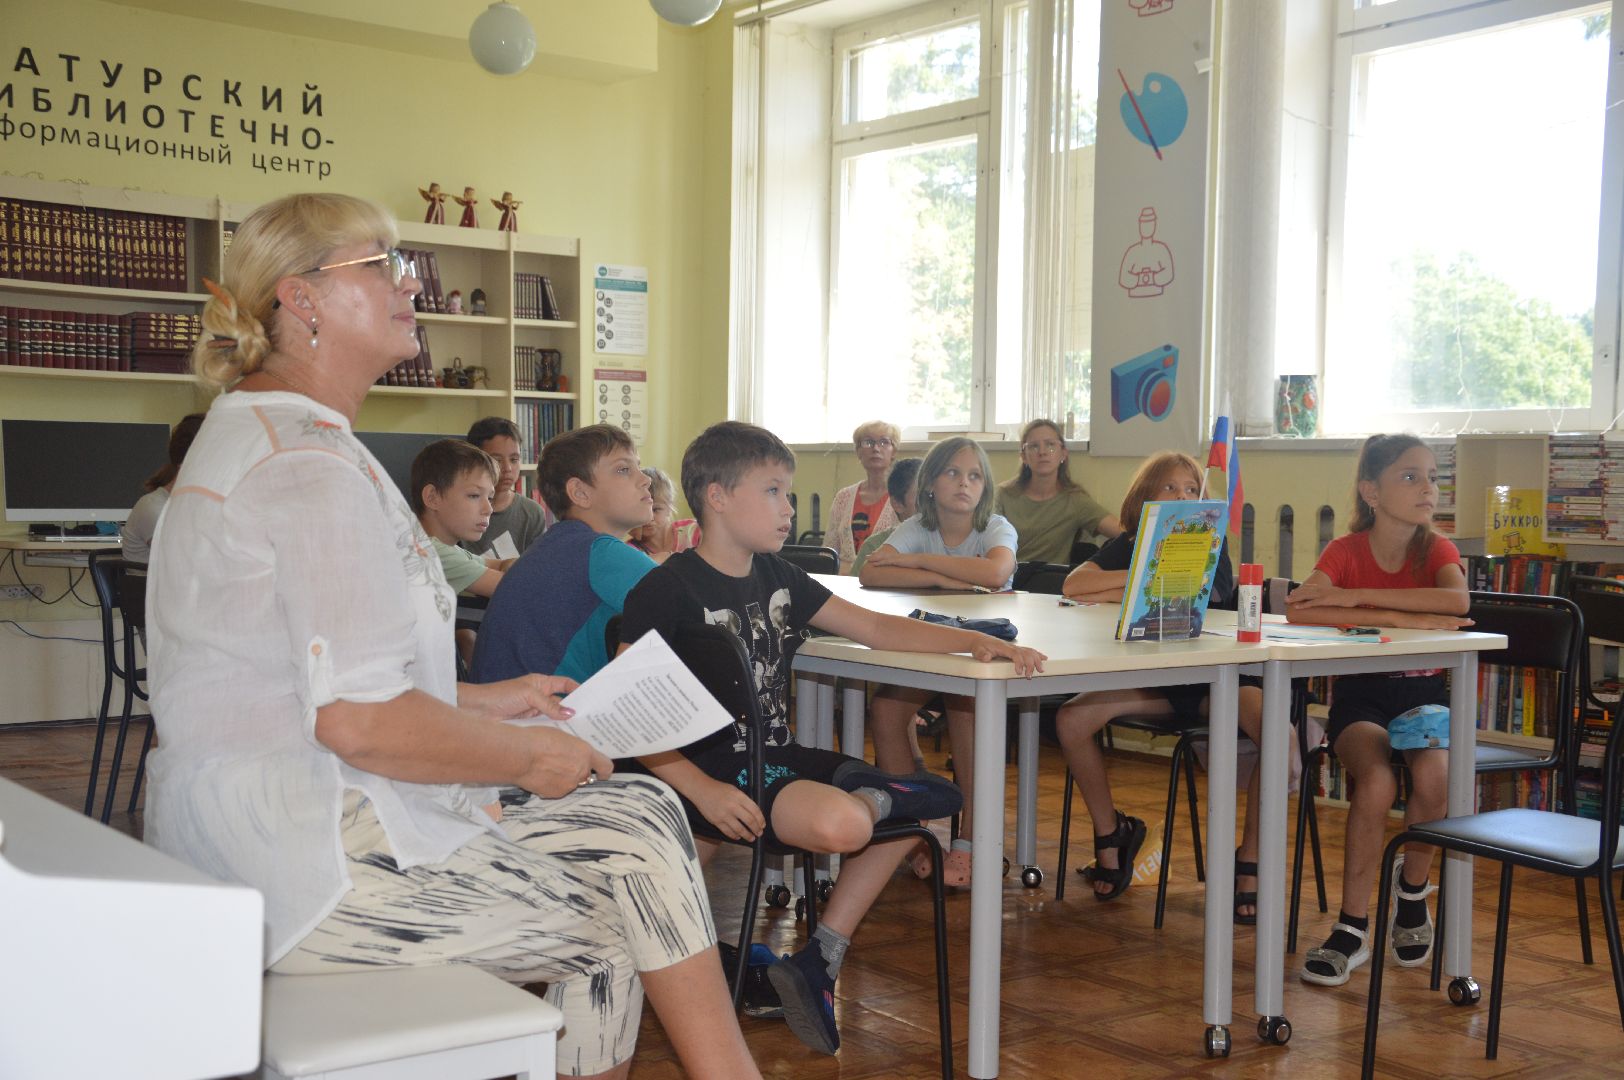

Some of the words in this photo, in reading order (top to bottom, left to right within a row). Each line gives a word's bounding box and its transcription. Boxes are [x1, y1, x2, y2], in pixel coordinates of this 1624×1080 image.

[14, 46, 323, 117] АТУРСКИЙ
[0, 112, 232, 165] формационный
[252, 152, 332, 181] центр
[1494, 512, 1543, 530] БУККРО
